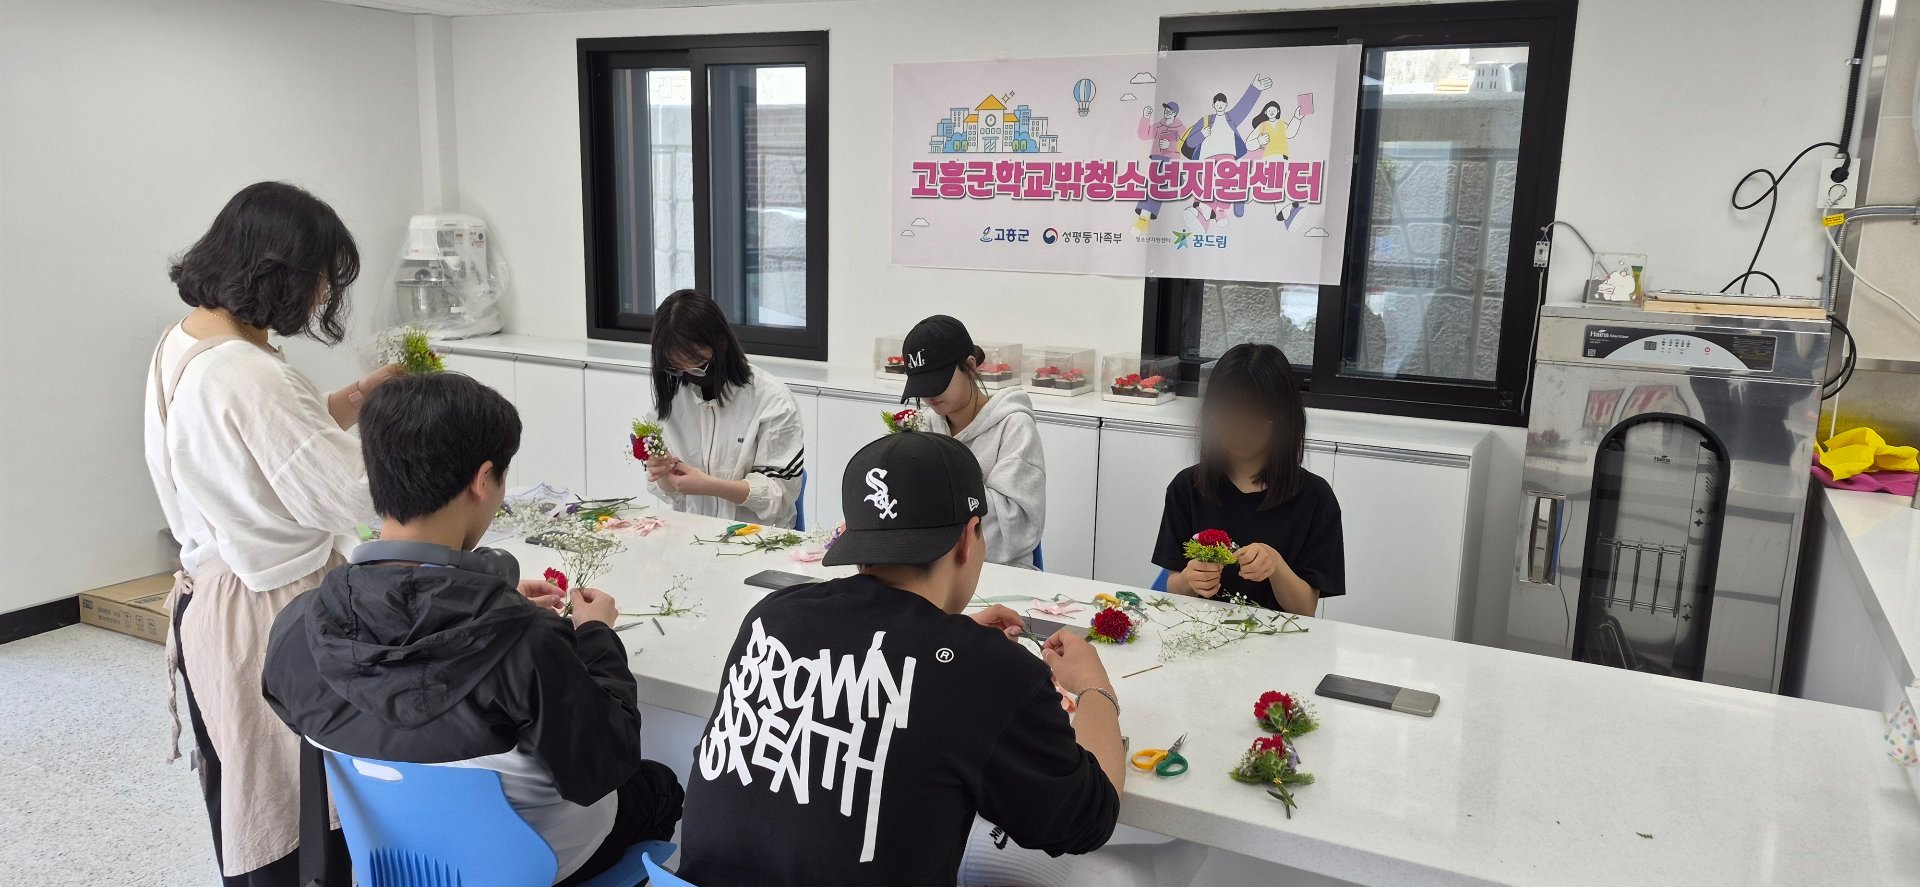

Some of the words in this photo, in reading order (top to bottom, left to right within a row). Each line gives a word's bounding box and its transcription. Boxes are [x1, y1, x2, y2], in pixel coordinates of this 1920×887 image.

[911, 159, 1324, 203] 고흥군학교밖청소년지원센터
[994, 228, 1030, 242] 고흥군
[1061, 231, 1123, 244] 성평등가족부
[1192, 234, 1228, 249] 꿈드림
[730, 617, 917, 728] BROWN
[699, 683, 897, 863] BREATH
